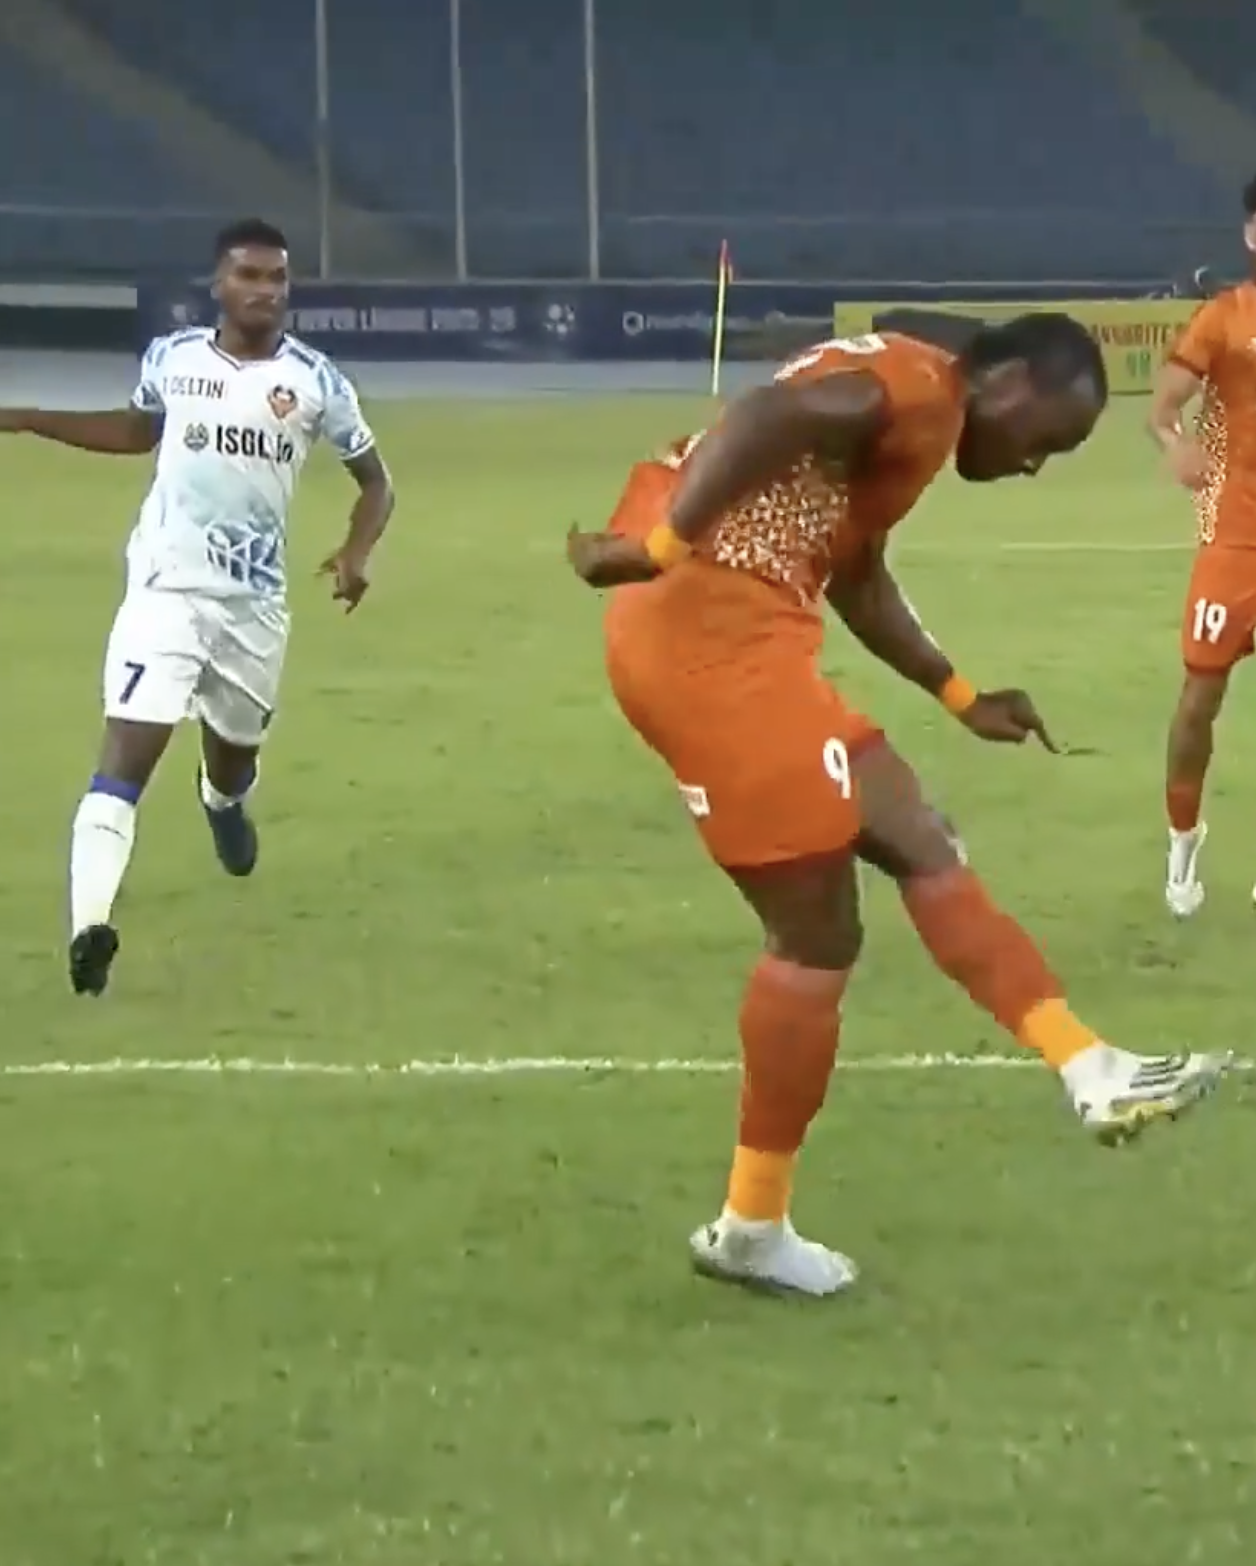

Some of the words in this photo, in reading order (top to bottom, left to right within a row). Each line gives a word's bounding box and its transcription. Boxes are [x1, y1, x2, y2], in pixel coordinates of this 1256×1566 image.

[1193, 598, 1227, 644] 19
[118, 661, 146, 704] 7
[823, 738, 851, 799] 9
